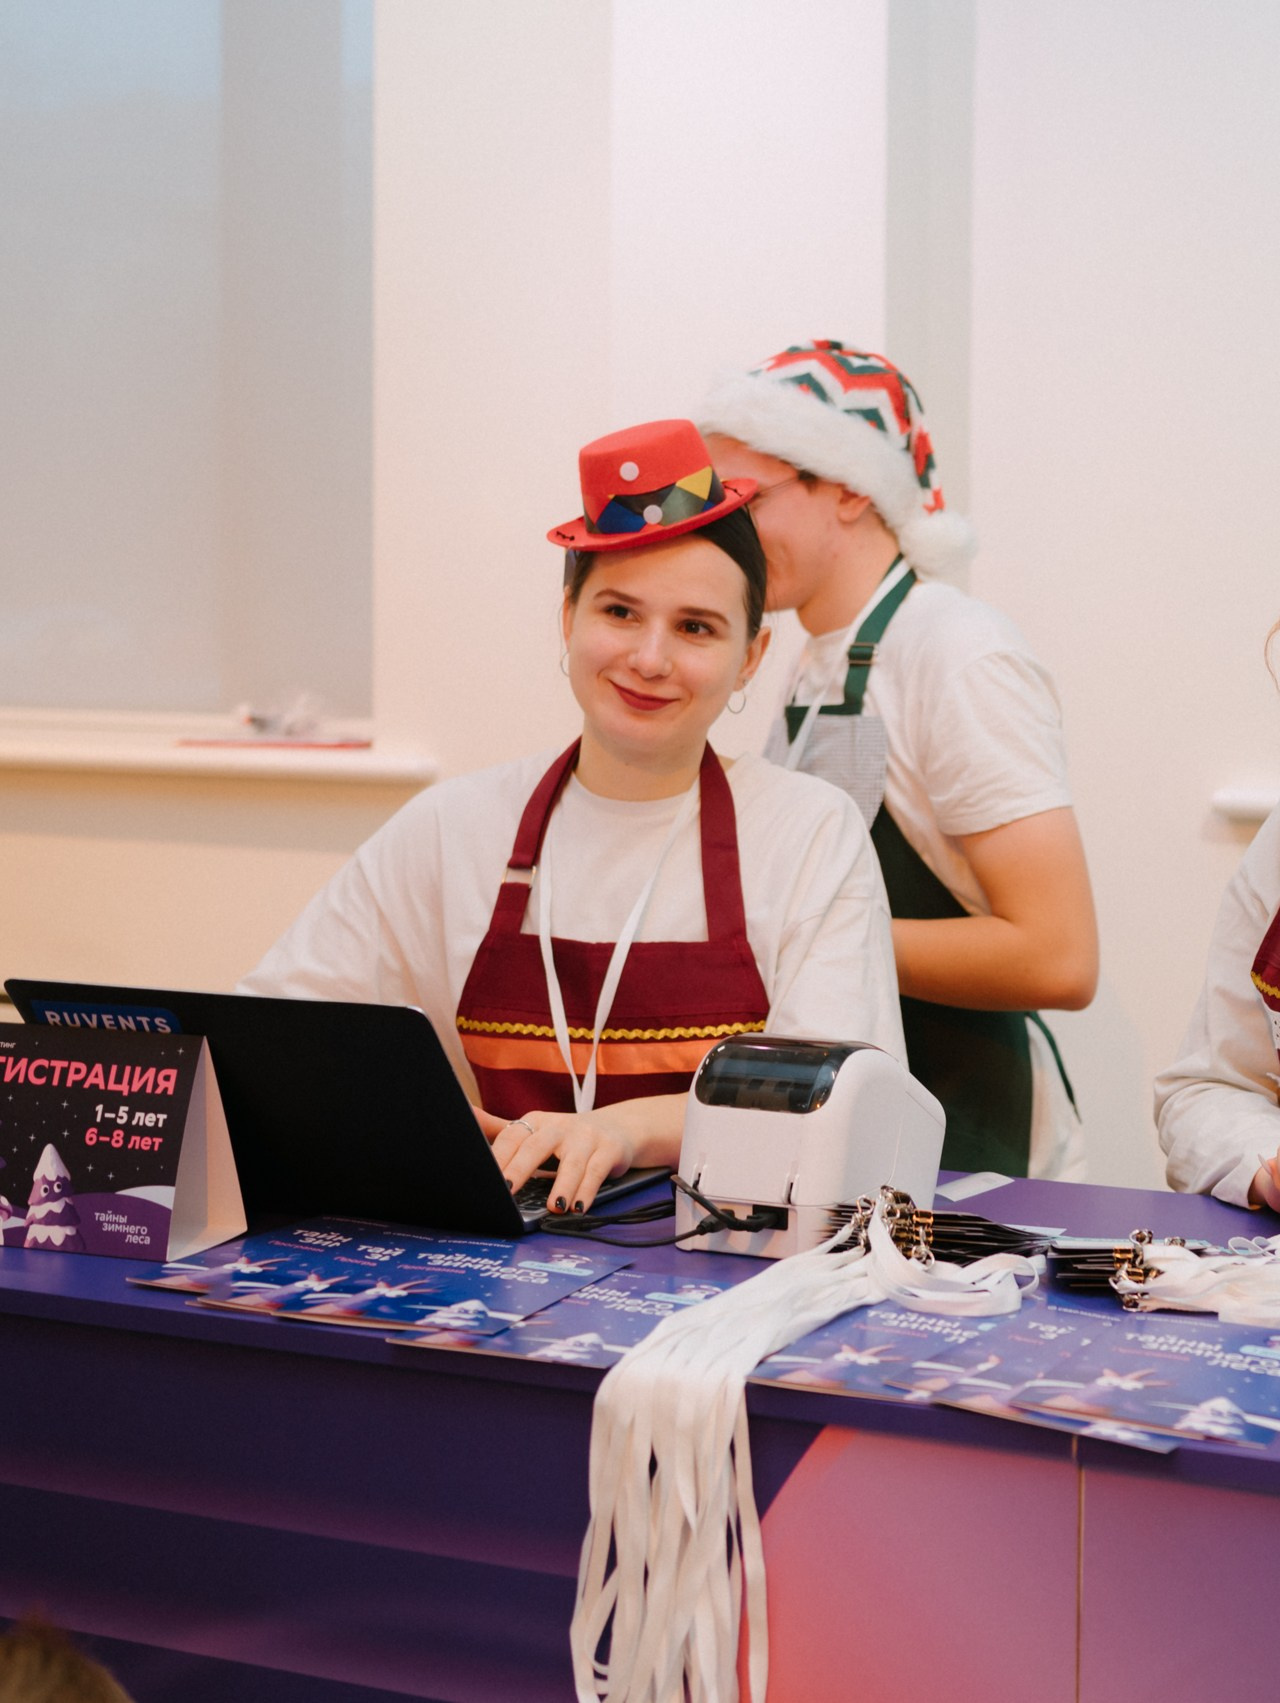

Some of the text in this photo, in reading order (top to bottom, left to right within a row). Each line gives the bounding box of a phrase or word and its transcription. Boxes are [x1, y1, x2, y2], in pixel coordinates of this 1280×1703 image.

[45, 1010, 172, 1034] RUVENTS
[0, 1055, 178, 1096] ИСТРАЦИЯ
[132, 1111, 168, 1128] лет
[128, 1135, 164, 1152] лет
[94, 1210, 128, 1224] тайны
[102, 1222, 148, 1235] зимнего
[293, 1229, 353, 1244] тайн
[125, 1234, 151, 1245] леса
[417, 1252, 504, 1267] тайны
[427, 1259, 549, 1278] зимнего
[479, 1271, 550, 1285] леса
[883, 1320, 980, 1339] зимне
